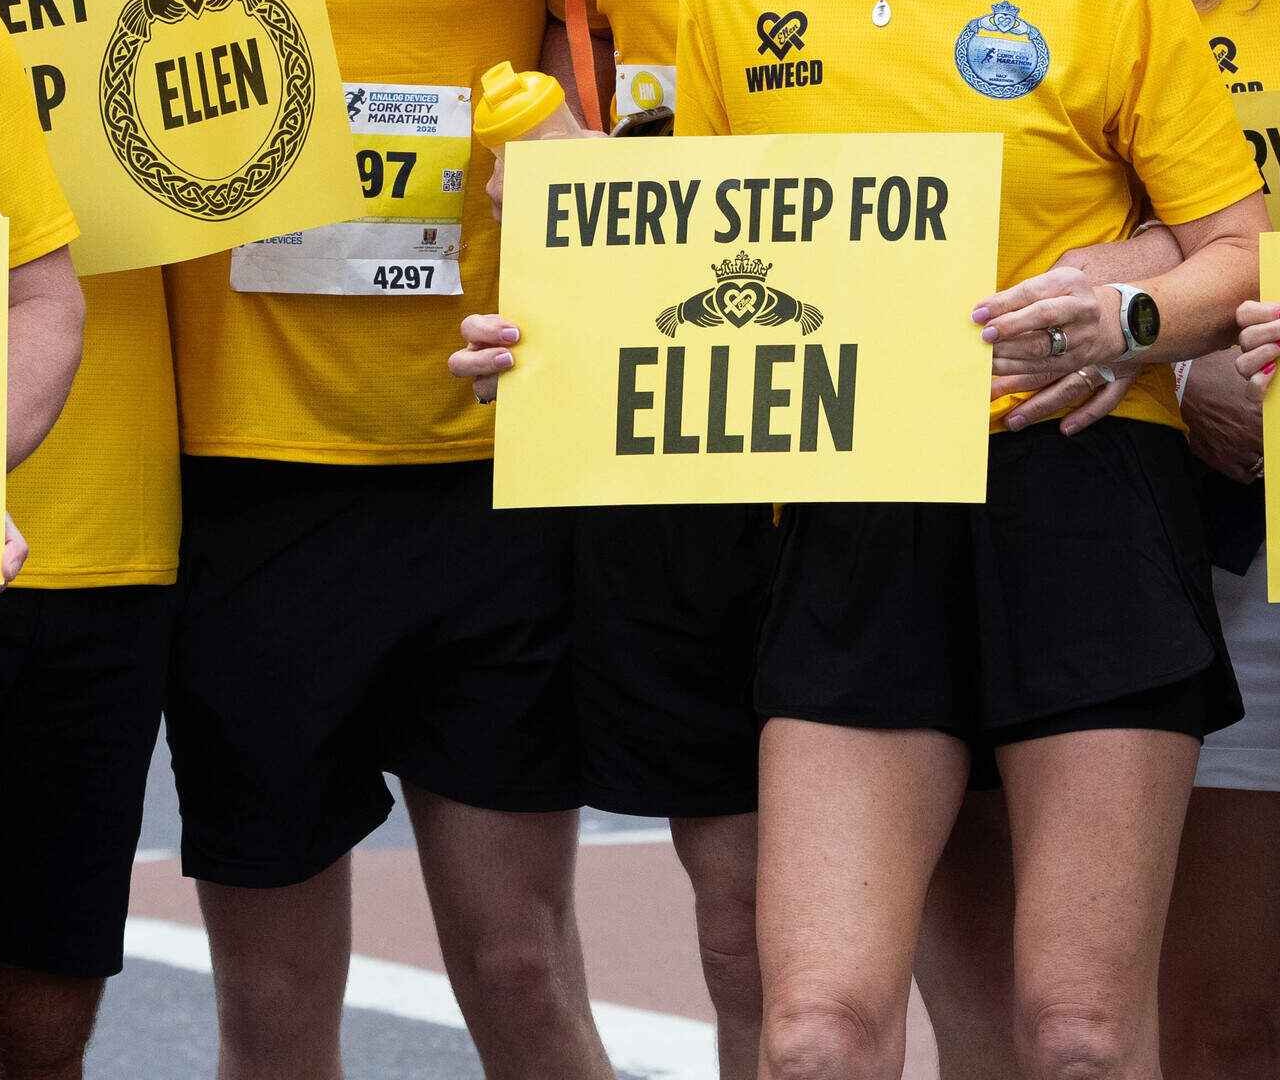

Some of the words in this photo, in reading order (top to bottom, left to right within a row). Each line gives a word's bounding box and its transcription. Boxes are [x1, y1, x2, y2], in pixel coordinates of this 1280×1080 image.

[155, 38, 268, 130] ELLEN
[745, 59, 823, 93] WWECD
[369, 103, 404, 113] CORK
[405, 103, 433, 114] CITY
[371, 94, 403, 102] ANALOG
[404, 94, 438, 103] DEVICES
[367, 114, 439, 125] MARATHON
[546, 180, 701, 247] EVERY
[714, 178, 833, 243] STEP
[850, 176, 948, 241] FOR
[265, 236, 303, 245] DEVICES
[373, 266, 435, 290] 4297
[616, 344, 858, 455] ELLEN
